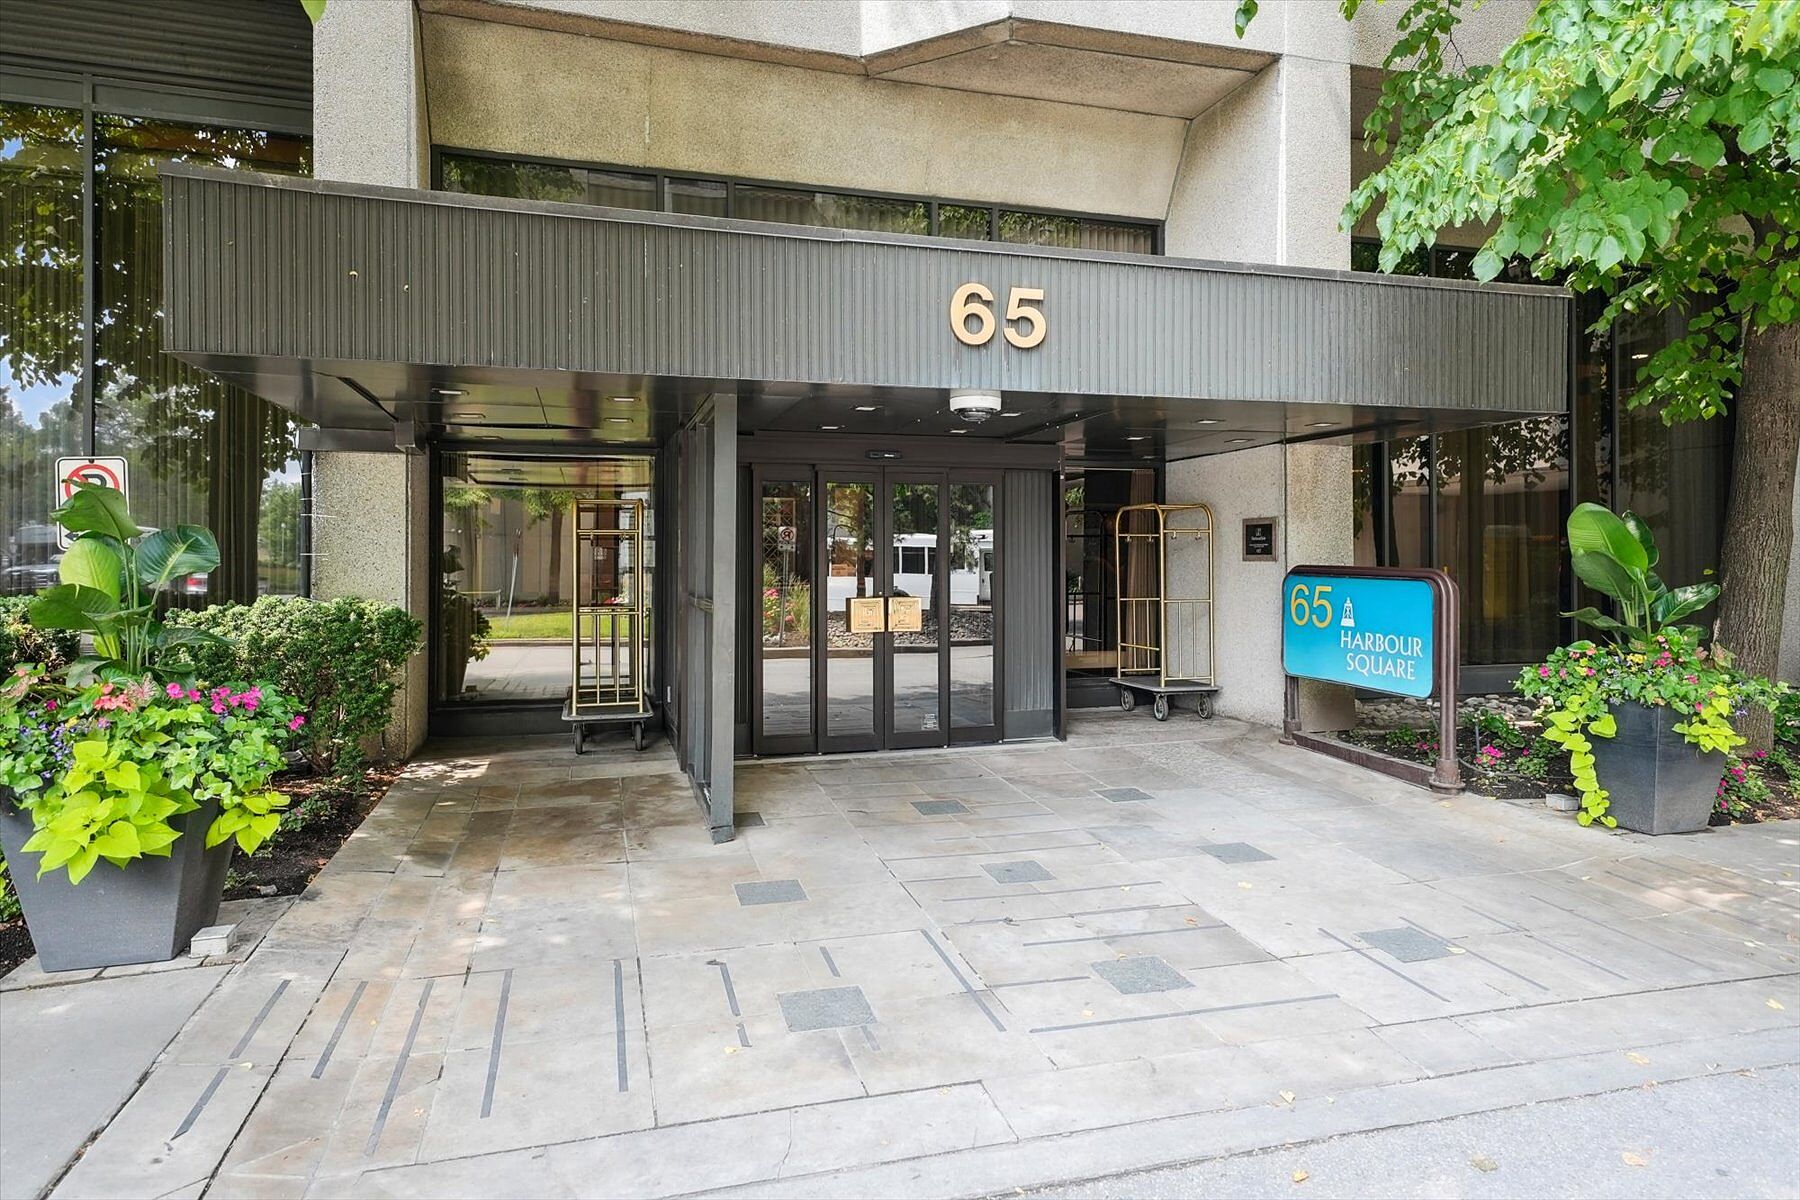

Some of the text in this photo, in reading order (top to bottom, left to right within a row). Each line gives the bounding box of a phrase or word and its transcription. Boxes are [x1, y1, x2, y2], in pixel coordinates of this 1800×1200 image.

[950, 282, 1047, 349] 65
[1290, 584, 1333, 628] 65
[1340, 629, 1423, 658] HARBOUR
[1346, 652, 1415, 680] SQUARE
